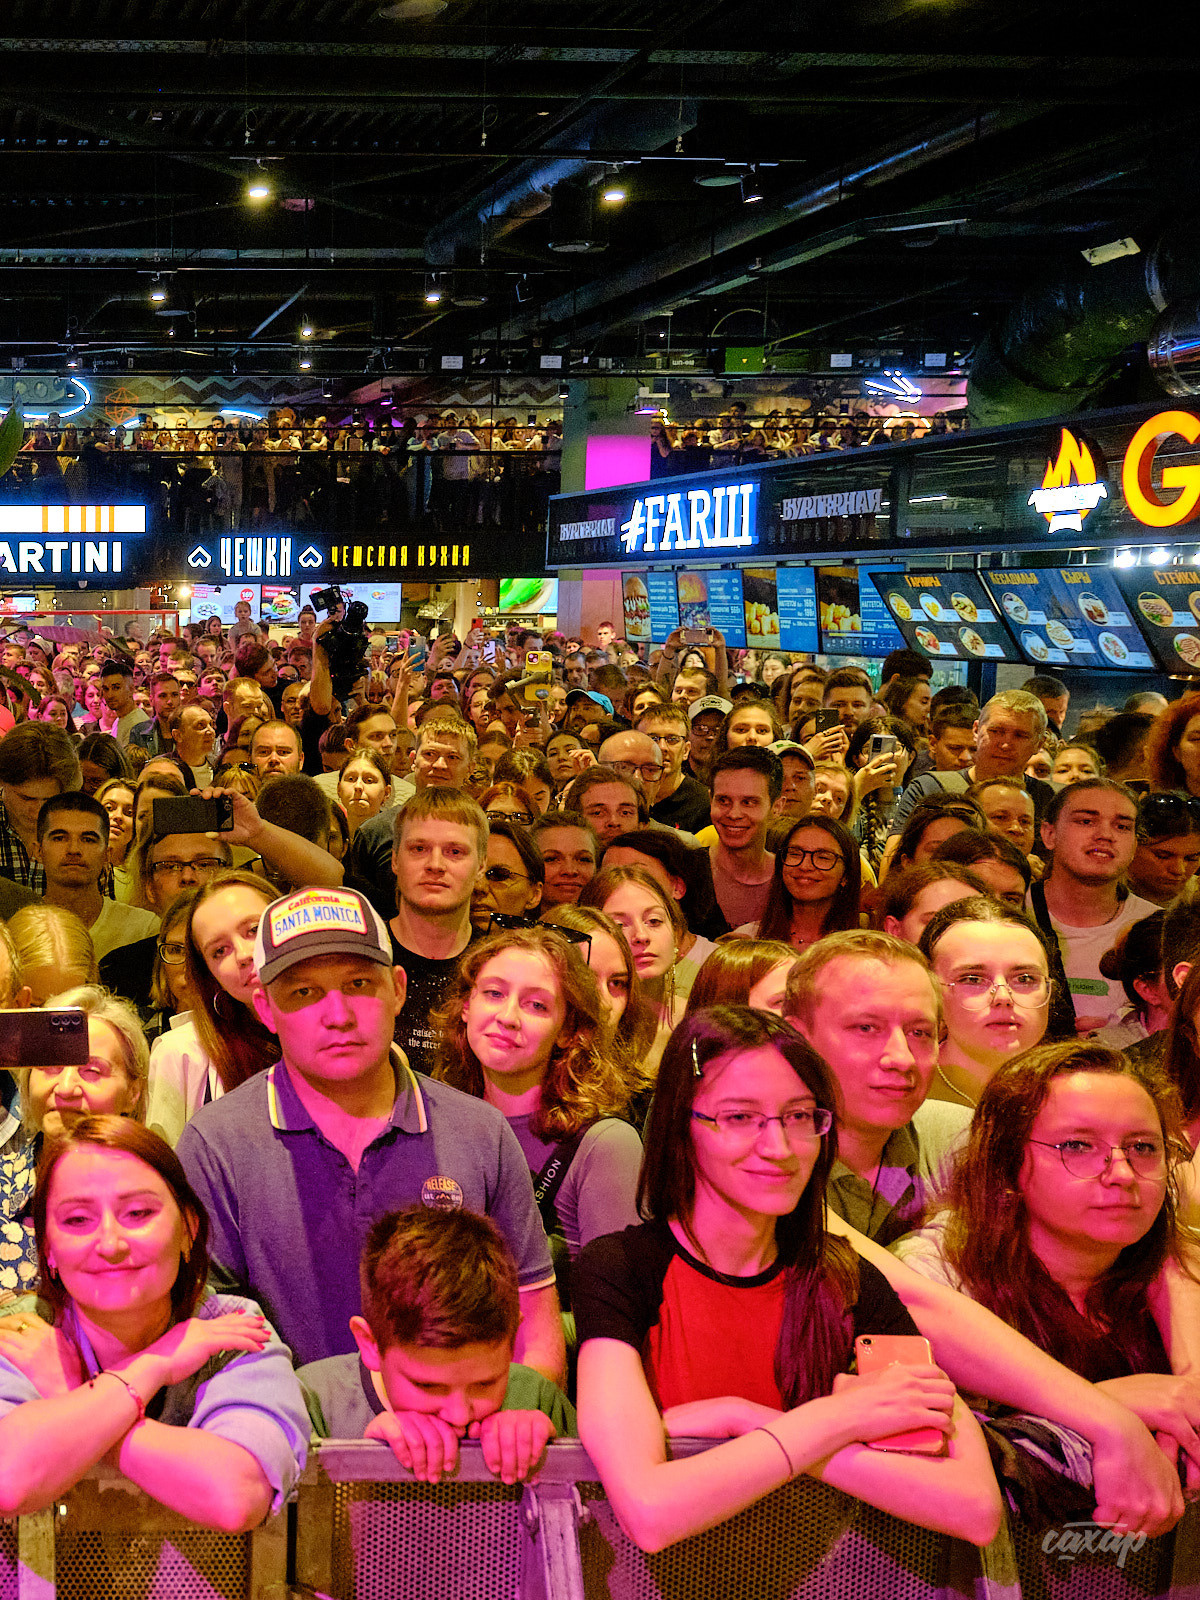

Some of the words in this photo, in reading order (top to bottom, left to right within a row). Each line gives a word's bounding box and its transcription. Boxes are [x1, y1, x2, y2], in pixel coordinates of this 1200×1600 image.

[1122, 410, 1200, 528] G
[782, 488, 883, 521] БУРГЕРНАЯ
[559, 517, 616, 541] БУРГЕРНАЯ
[220, 537, 292, 577] ЧЕШКИ
[331, 545, 408, 567] ЧЕШСКАЯ
[417, 545, 470, 567] КУХНЯ
[288, 895, 341, 911] California
[274, 908, 311, 937] SANTA
[313, 905, 362, 925] MONICA
